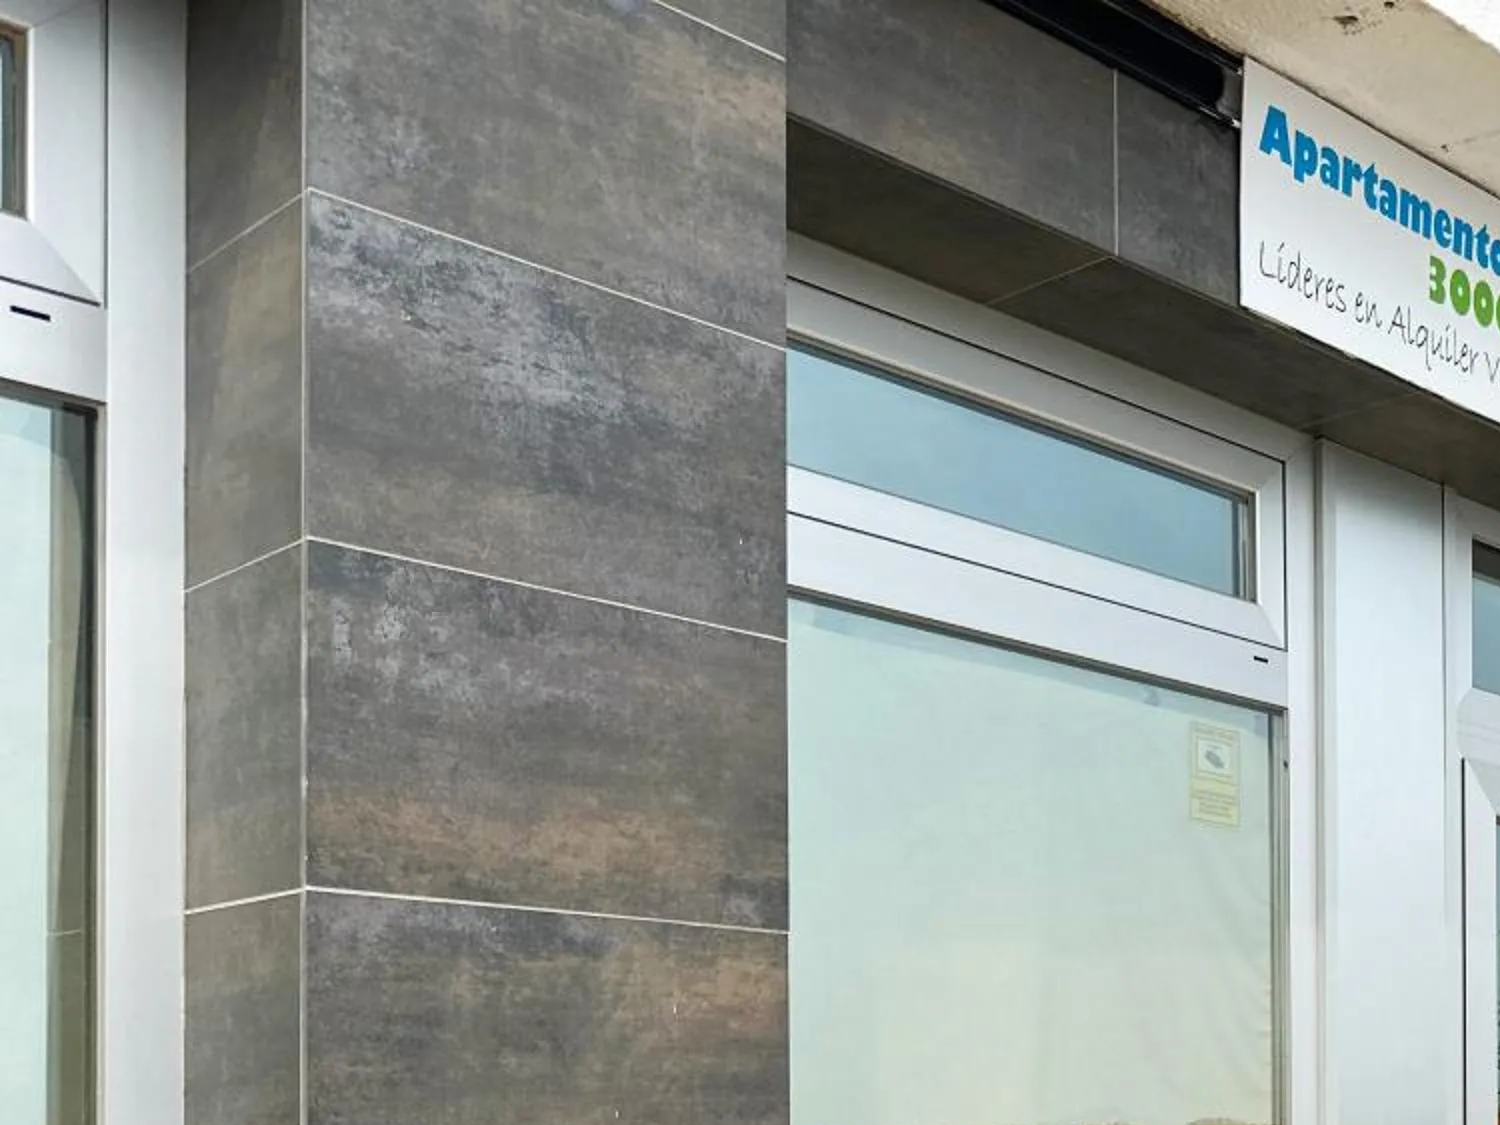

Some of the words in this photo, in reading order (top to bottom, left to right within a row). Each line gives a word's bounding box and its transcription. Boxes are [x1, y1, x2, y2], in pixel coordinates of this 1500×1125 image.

[1258, 240, 1346, 313] Líderes
[1354, 291, 1383, 329] en
[1390, 304, 1477, 372] Alquiler
